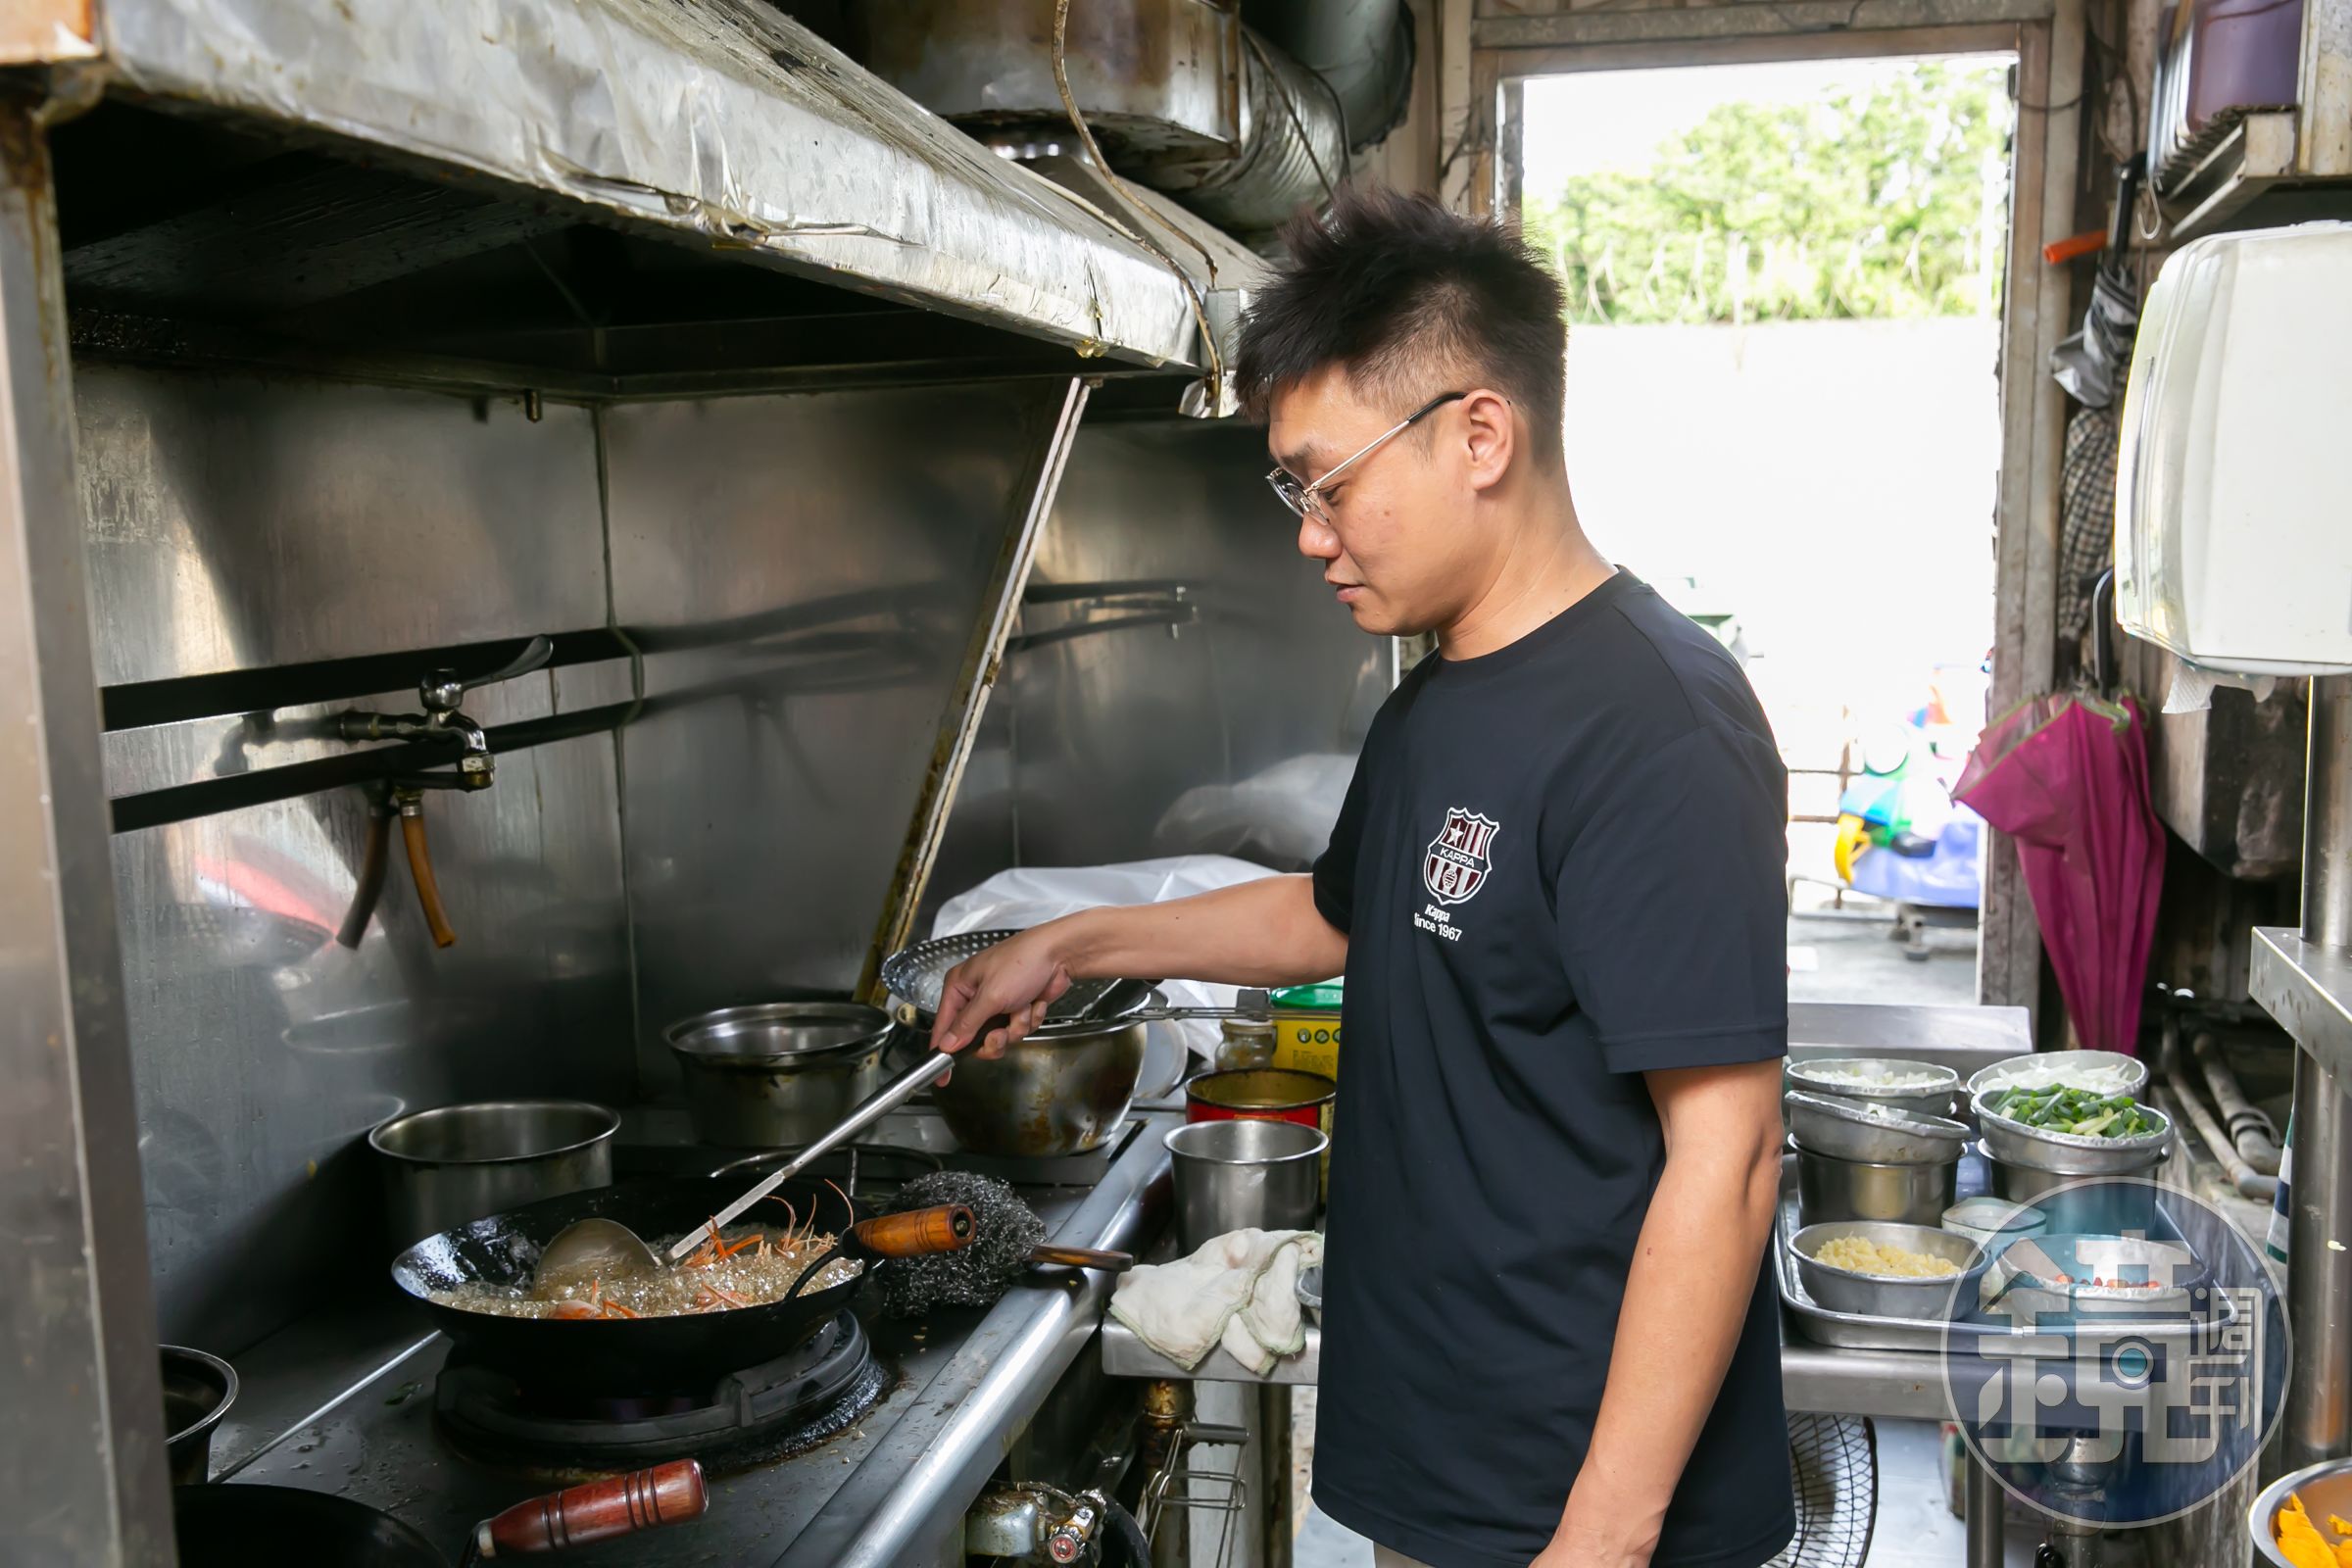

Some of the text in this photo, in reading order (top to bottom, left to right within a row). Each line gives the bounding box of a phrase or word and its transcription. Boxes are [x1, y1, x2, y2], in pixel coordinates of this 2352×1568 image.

[1440, 847, 1475, 868] KAPPA
[1424, 904, 1450, 923] Kappa
[1438, 923, 1463, 942] 1967
